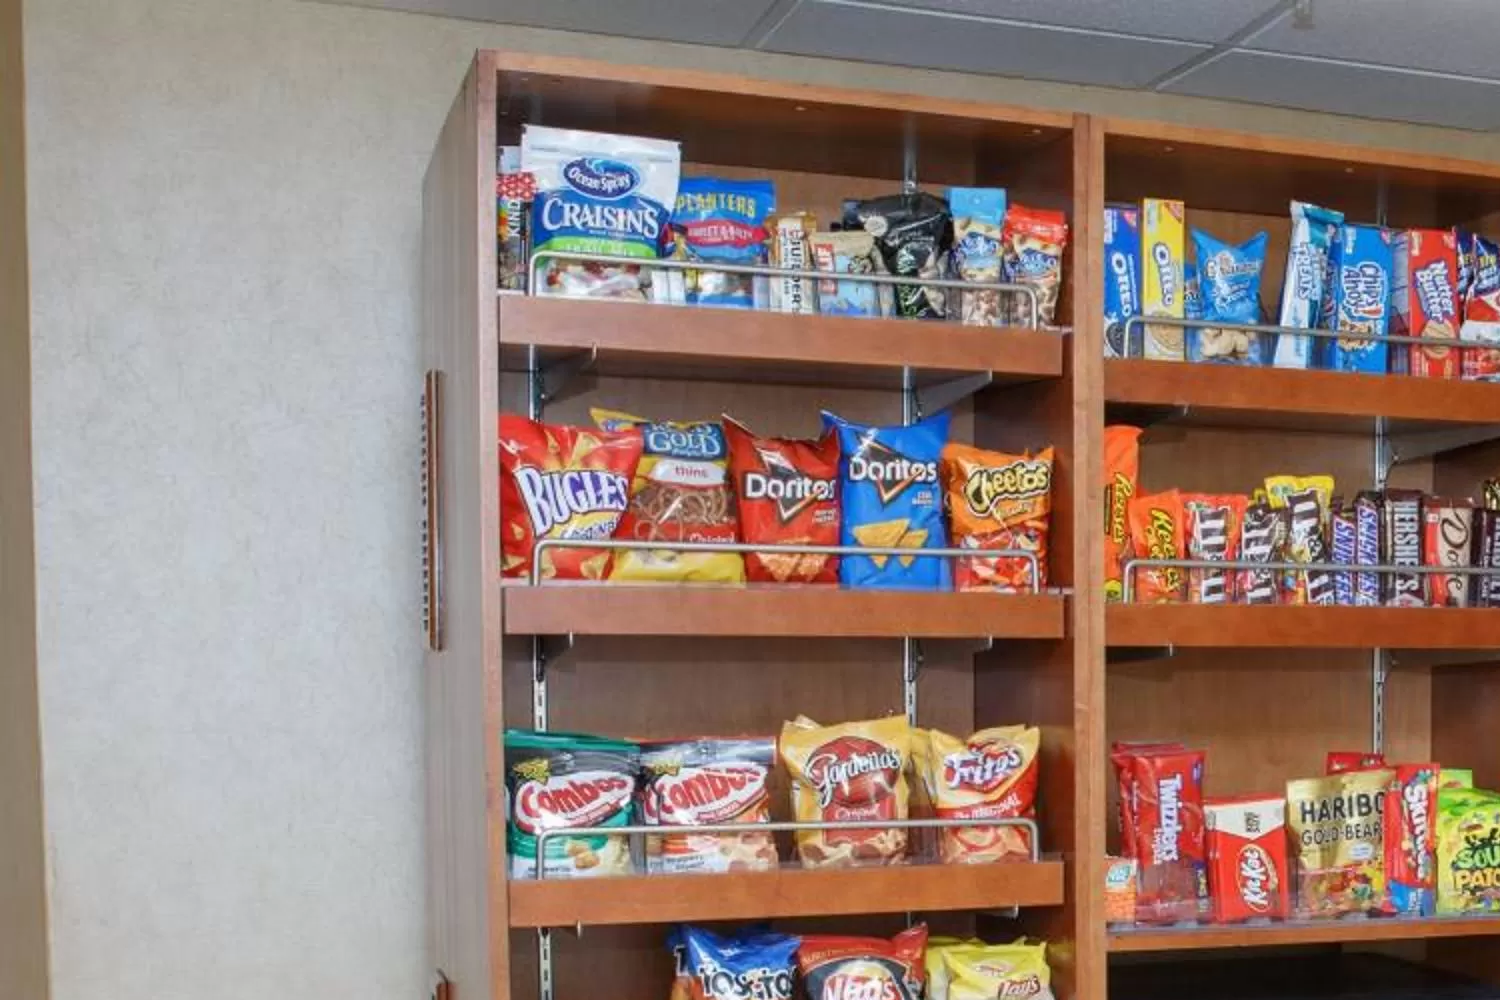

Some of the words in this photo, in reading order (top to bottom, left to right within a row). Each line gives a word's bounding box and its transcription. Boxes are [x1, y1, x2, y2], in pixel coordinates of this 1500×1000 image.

[507, 198, 521, 237] KIND
[543, 198, 660, 240] CRAISINS
[674, 190, 757, 218] PLANTERS
[745, 473, 836, 500] Doritos
[849, 459, 937, 483] Doritos
[965, 461, 1049, 516] Cheetos
[516, 464, 628, 540] BUGLES
[1333, 517, 1355, 605] SNICERS
[1358, 505, 1378, 595] SNICKRS
[1394, 501, 1418, 592] HERSHE'S
[1440, 507, 1469, 592] Doe
[944, 748, 1024, 788] Fritos
[515, 777, 631, 833] Combos
[1302, 822, 1384, 846] GOLD-BEAR
[998, 975, 1040, 999] Lay's
